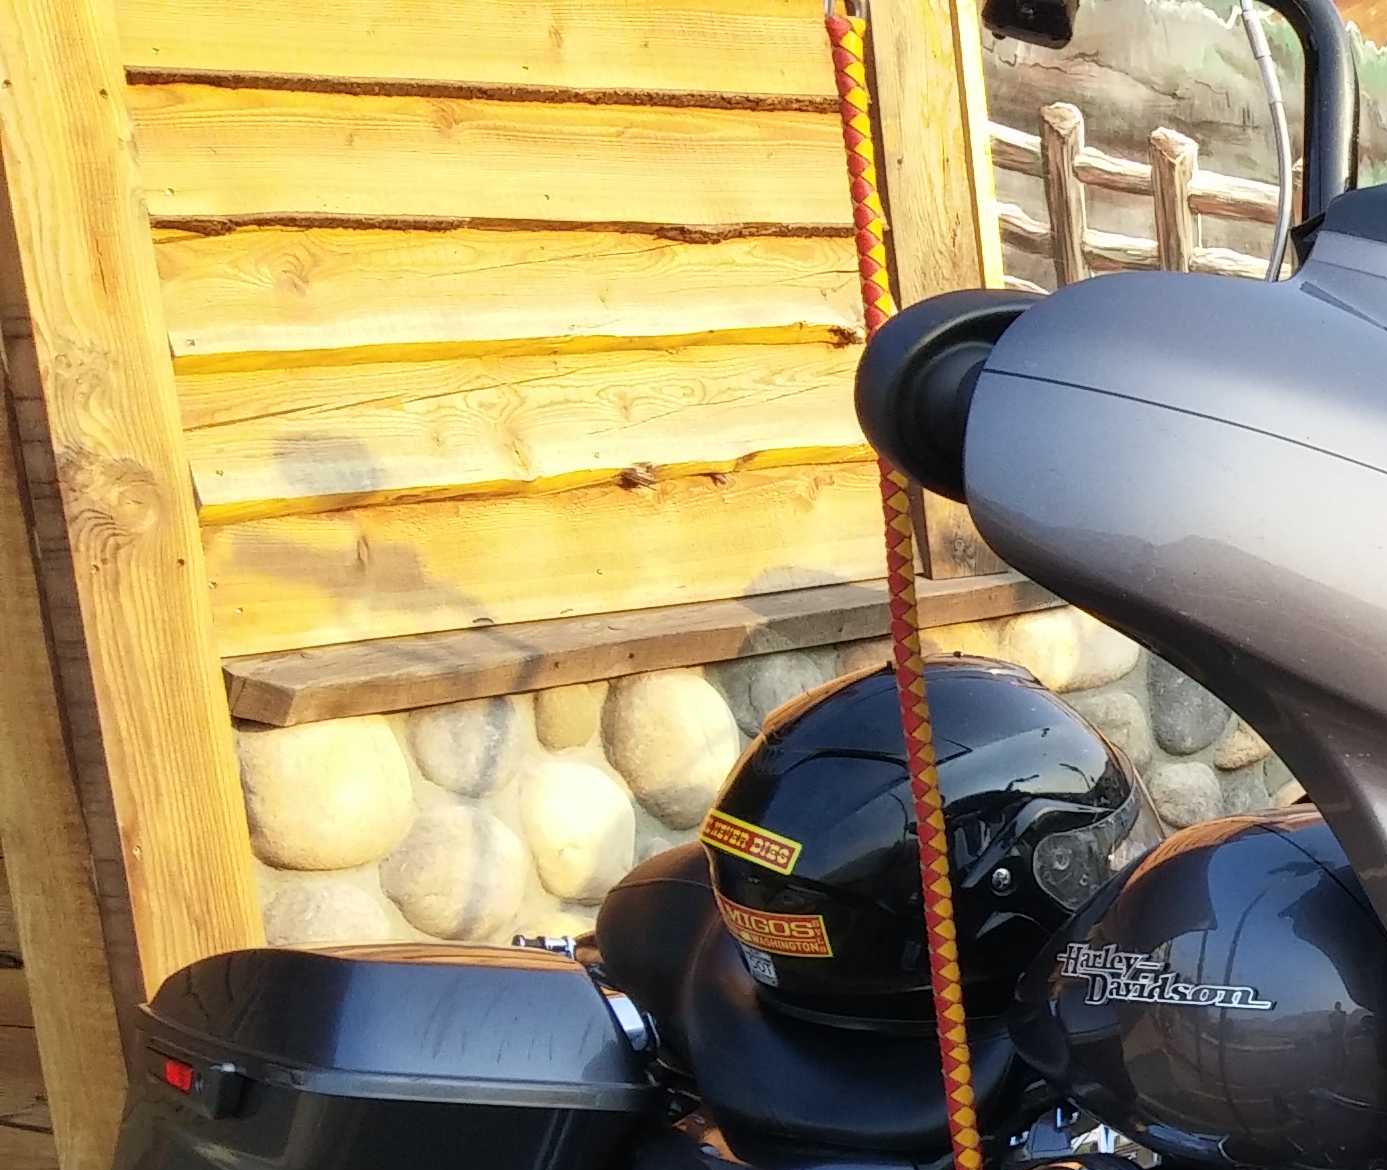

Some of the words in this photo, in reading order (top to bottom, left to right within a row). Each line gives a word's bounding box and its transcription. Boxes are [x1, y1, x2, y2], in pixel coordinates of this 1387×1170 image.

[711, 822, 750, 849] NEVER
[749, 837, 790, 865] DIES
[724, 903, 816, 938] MIGOS
[751, 933, 819, 953] WASHINGTON
[1084, 971, 1273, 1009] Davidson
